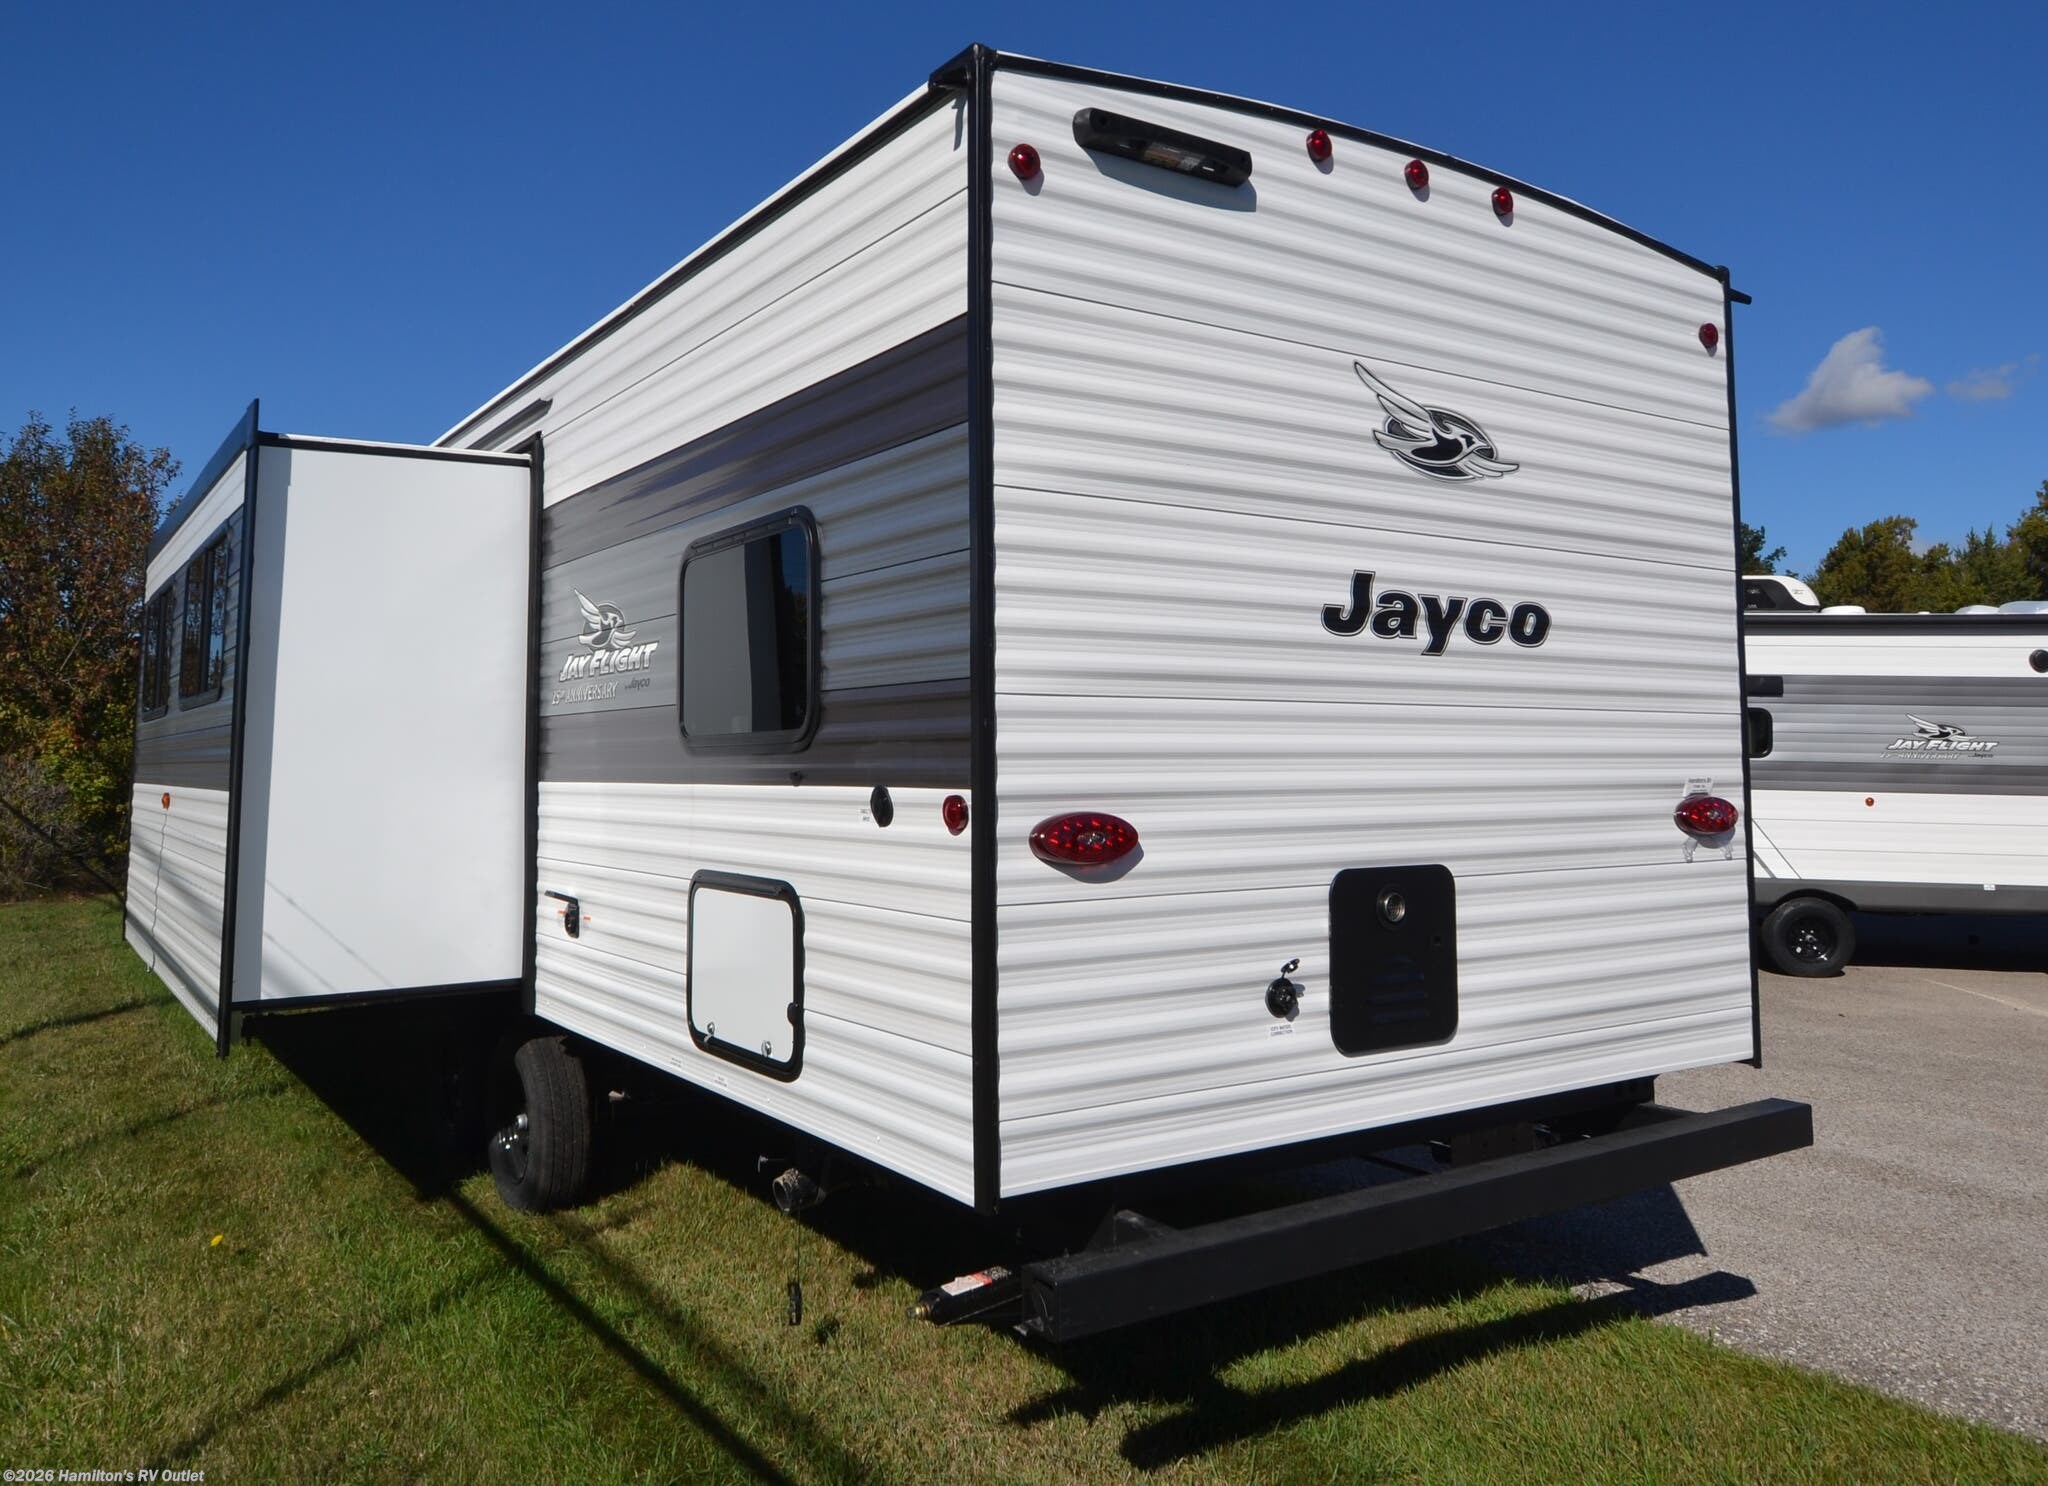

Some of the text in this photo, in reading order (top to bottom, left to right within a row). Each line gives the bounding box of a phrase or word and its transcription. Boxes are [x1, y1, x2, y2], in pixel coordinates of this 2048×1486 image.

[1321, 569, 1553, 657] Jayco
[559, 641, 660, 683] JAY FLIGHT
[565, 681, 619, 704] ANNIVERSARY
[1887, 738, 1999, 751] JAY FLIGHT
